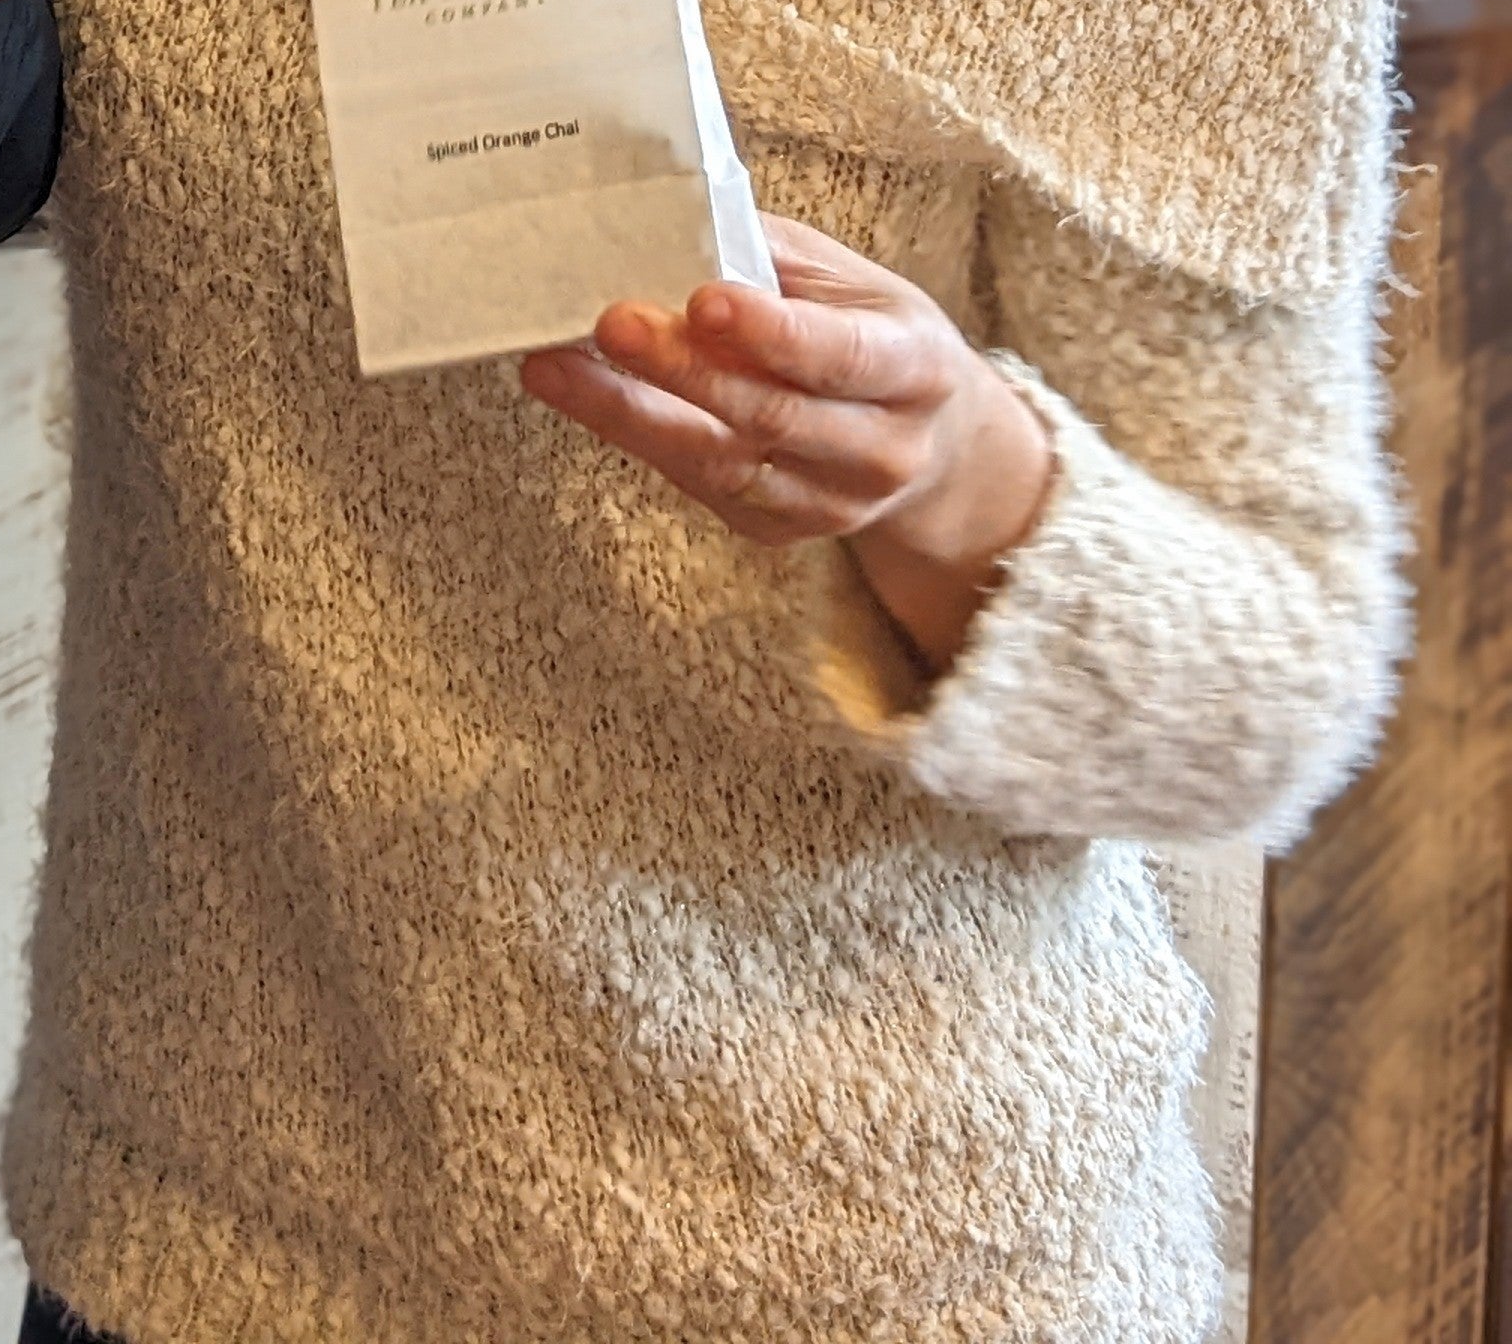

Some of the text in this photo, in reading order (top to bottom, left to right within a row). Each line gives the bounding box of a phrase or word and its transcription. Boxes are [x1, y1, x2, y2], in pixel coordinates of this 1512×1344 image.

[426, 118, 580, 163] Spiced Orange Chai
